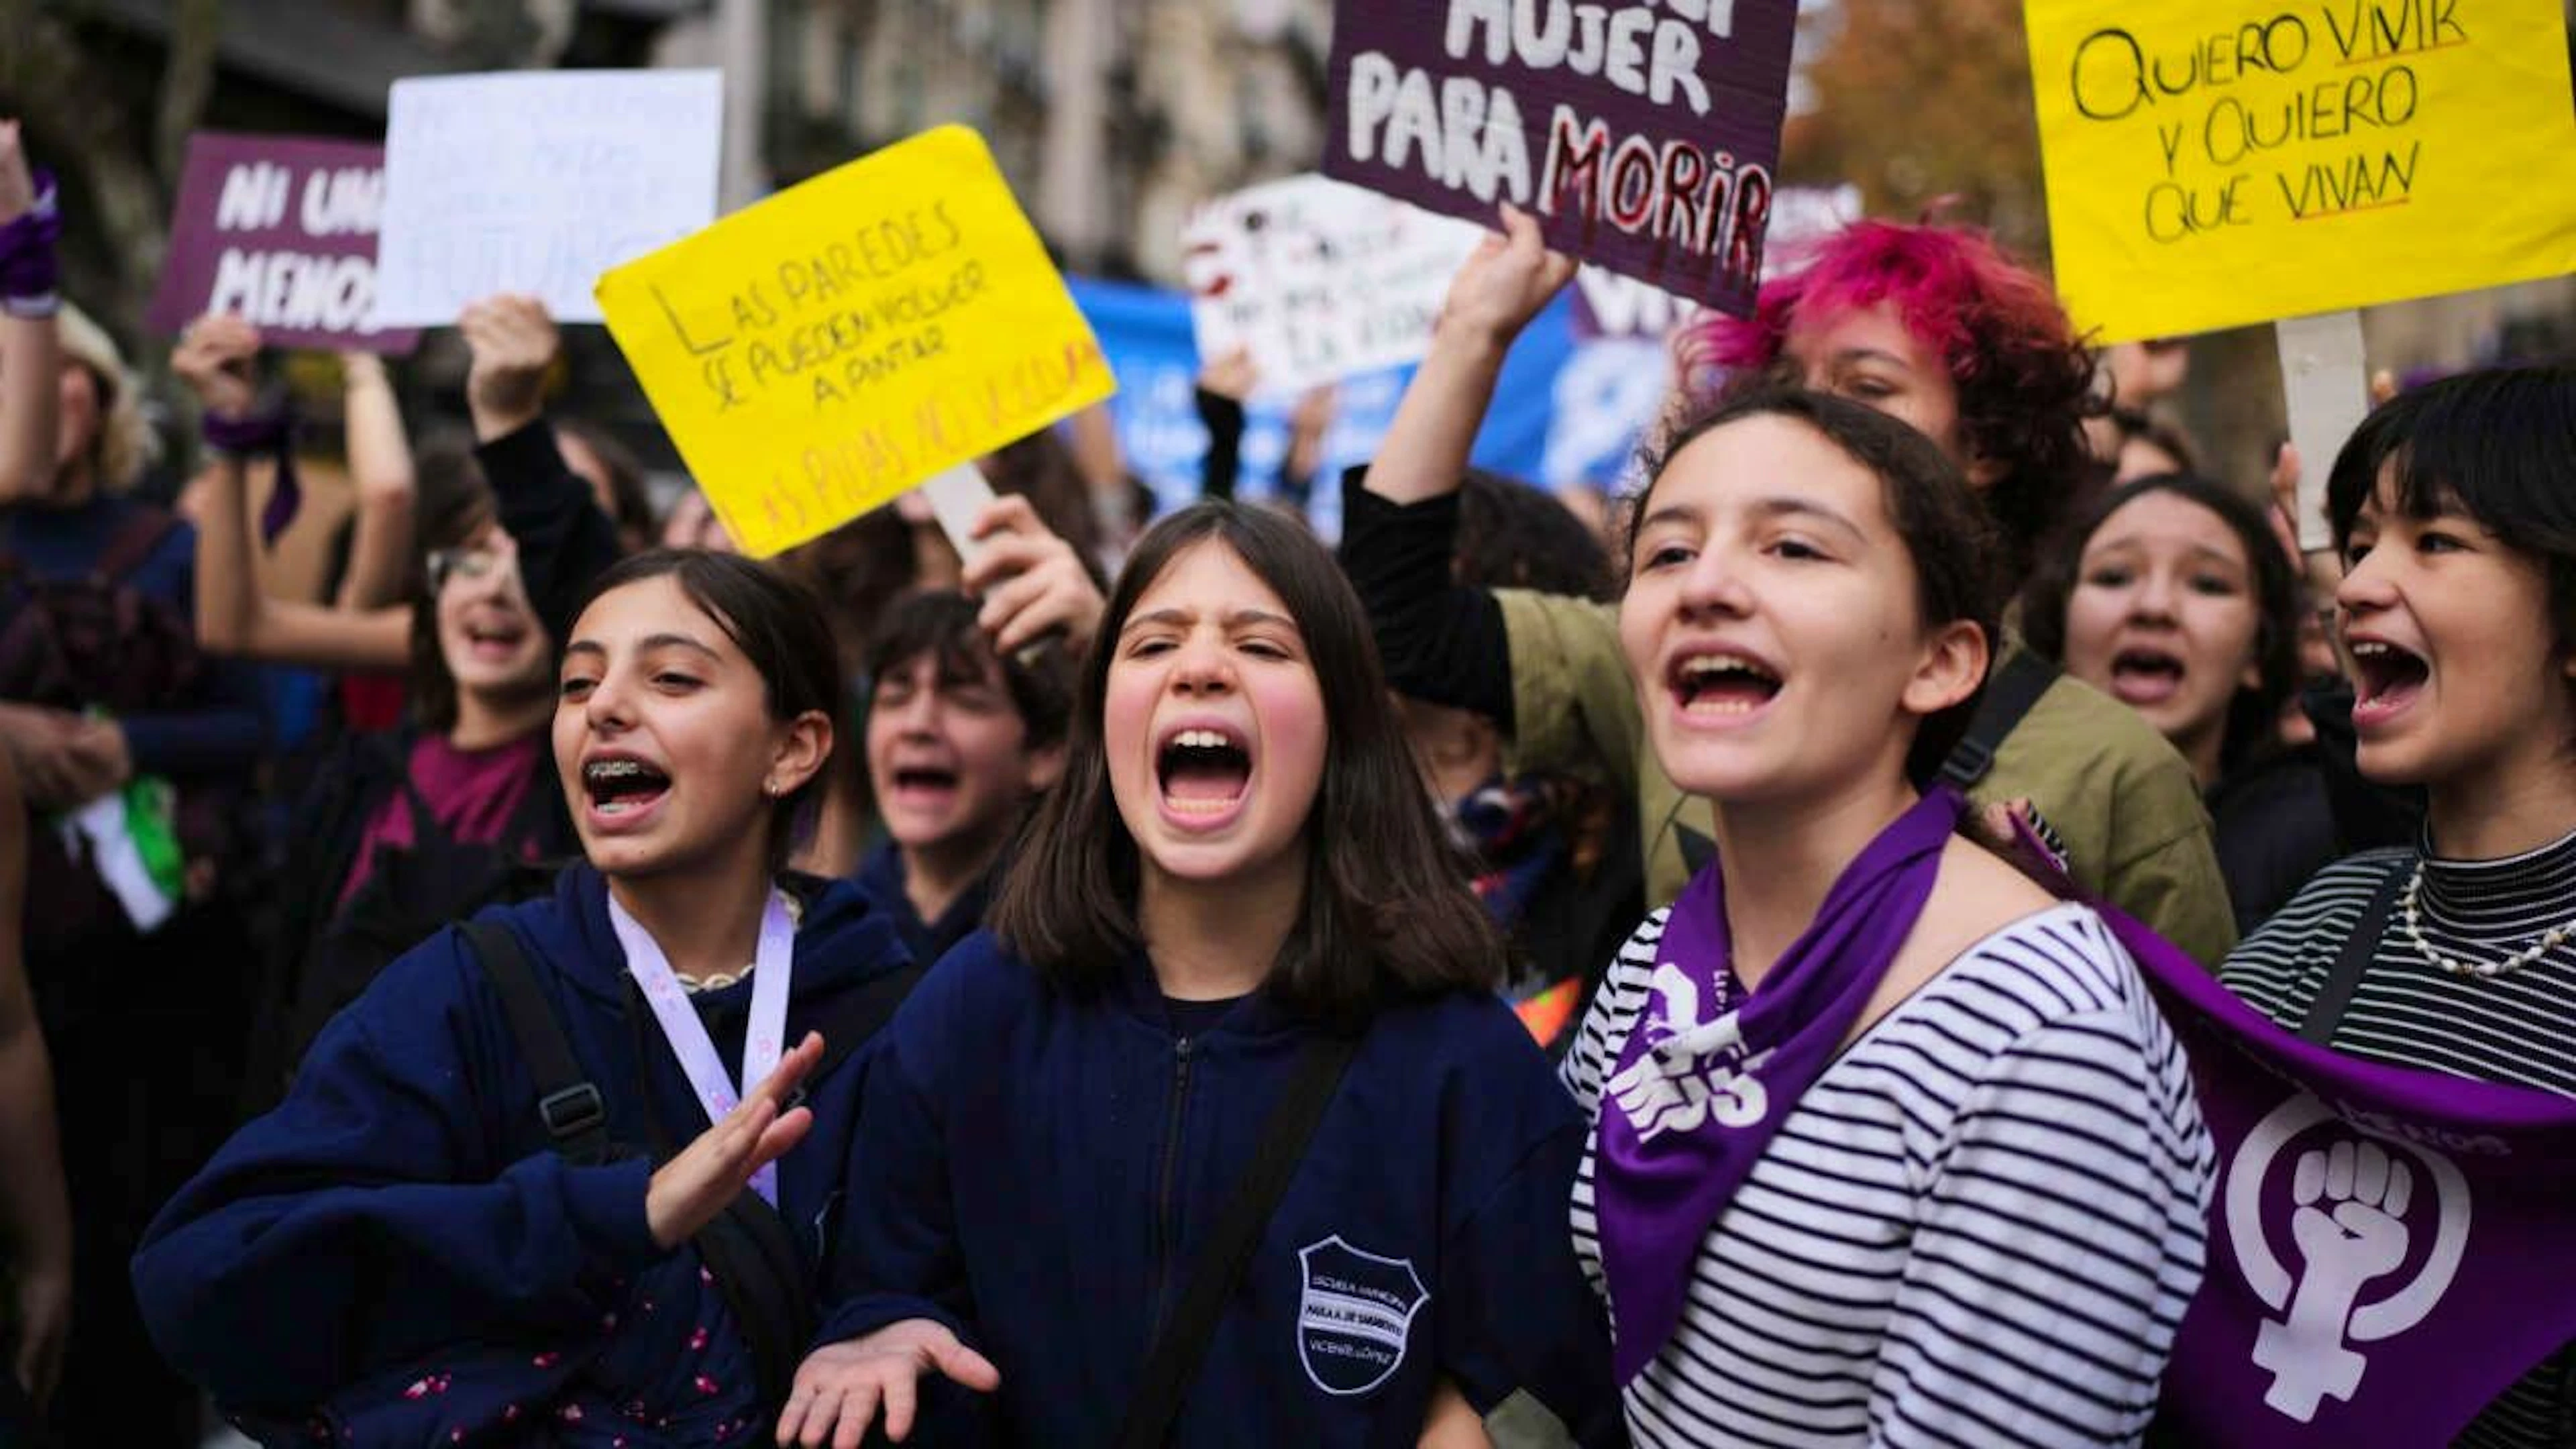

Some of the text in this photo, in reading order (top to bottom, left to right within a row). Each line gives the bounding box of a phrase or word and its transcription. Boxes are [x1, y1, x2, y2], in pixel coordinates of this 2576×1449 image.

[1445, 0, 1711, 117] MUJER
[2071, 0, 2467, 121] QUIERO VIVIR
[1347, 50, 1532, 204] PARA
[1537, 103, 1771, 284] MORIR
[2157, 65, 2416, 174] Y QUIERO
[215, 161, 292, 231] NI
[300, 166, 387, 237] UN
[2145, 140, 2419, 245] QUE VIVAN
[648, 199, 961, 356] LAS PAREDES
[747, 309, 869, 387] PUEDEN
[871, 259, 989, 332] VOLVER
[811, 325, 950, 411] A PINTAR
